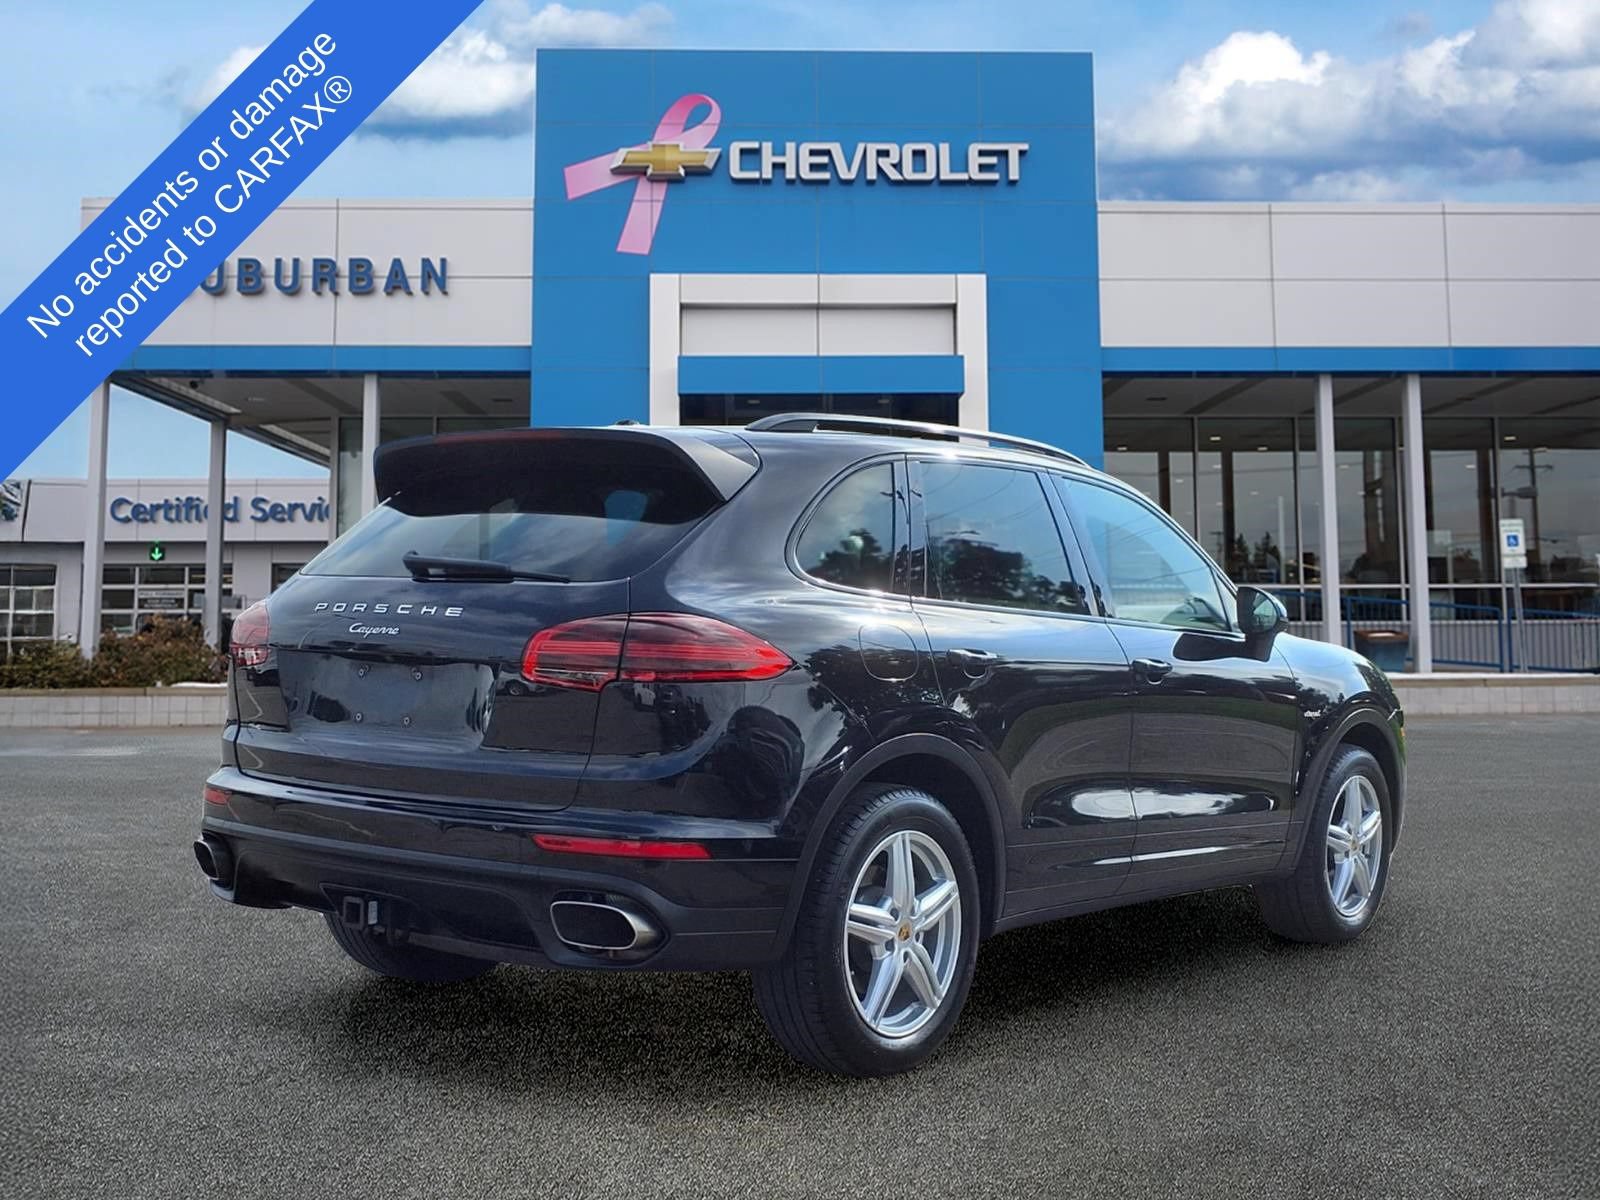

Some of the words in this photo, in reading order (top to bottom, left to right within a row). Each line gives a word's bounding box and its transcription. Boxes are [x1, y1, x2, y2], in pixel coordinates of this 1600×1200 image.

[729, 140, 1030, 185] CHEVROLET
[201, 257, 448, 297] UBURBAN
[314, 602, 464, 618] PORSCHE
[348, 622, 401, 639] Cayenne
